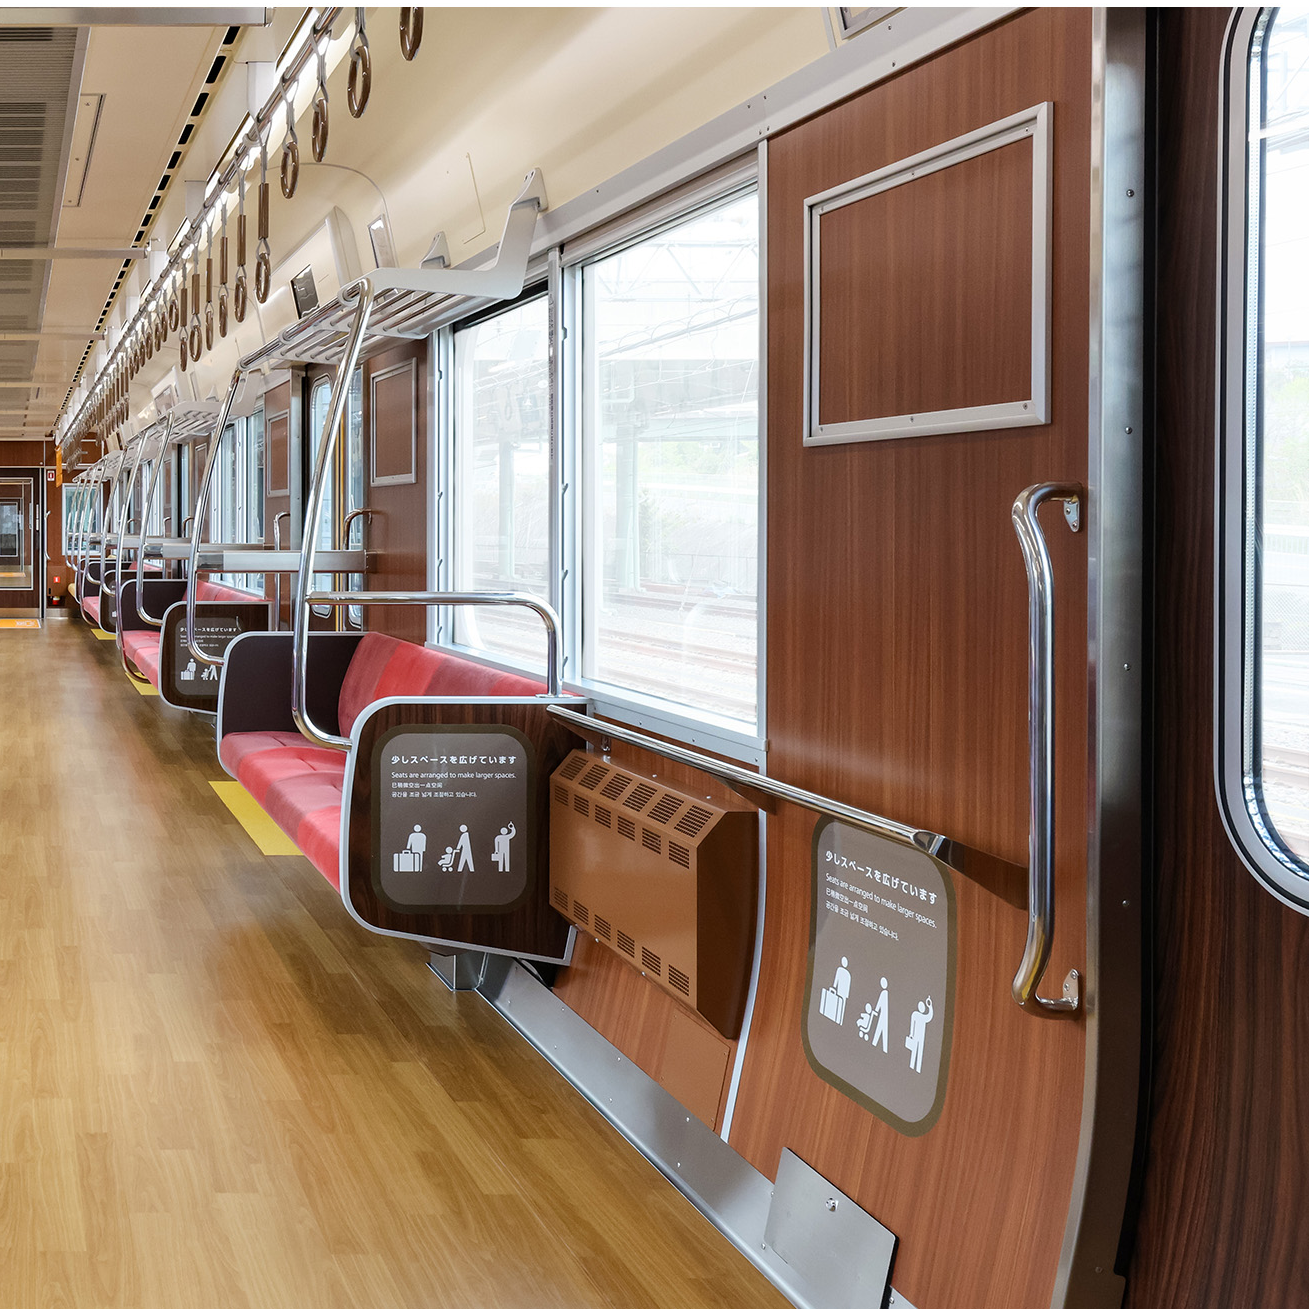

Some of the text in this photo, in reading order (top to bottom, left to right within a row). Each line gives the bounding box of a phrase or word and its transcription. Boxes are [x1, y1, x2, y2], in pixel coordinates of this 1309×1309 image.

[391, 755, 517, 765] 少しスペースを広げています
[476, 772, 493, 780] larger
[826, 850, 937, 905] 少しスペースを広げています
[826, 873, 937, 928] Seats are arranged to make larger spaces.
